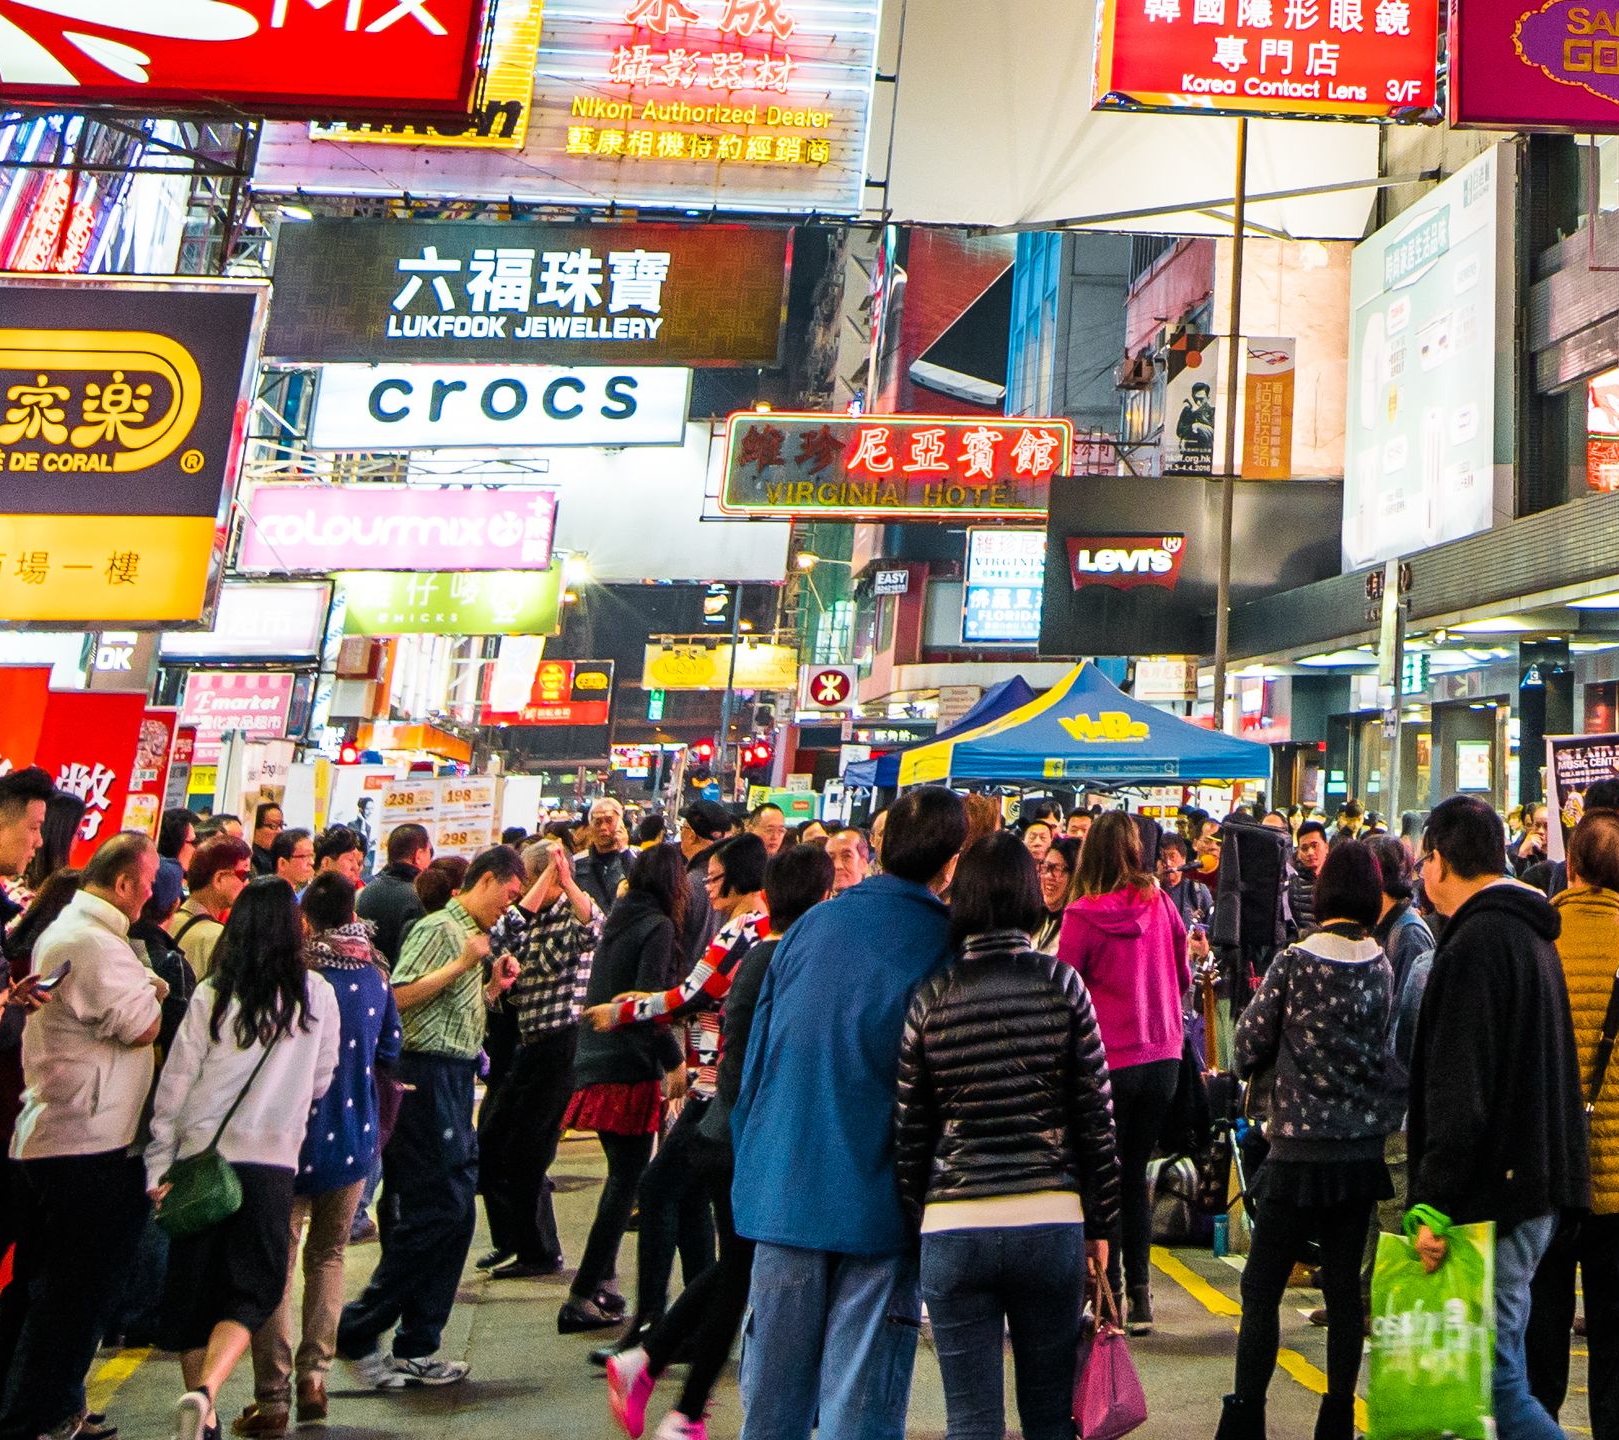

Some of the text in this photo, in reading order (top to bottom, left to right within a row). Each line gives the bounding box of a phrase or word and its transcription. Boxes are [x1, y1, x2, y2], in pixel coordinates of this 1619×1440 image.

[1212, 37, 1340, 77] 專門店
[1182, 74, 1421, 102] Korea Contact Lens 3/F
[641, 98, 834, 129] Authorized Dealer
[392, 247, 672, 315] 六福珠寶
[387, 316, 664, 341] LUKFOOK JEWELLERY
[367, 370, 640, 426] crocs
[10, 453, 113, 474] DE CORAL
[766, 481, 904, 510] VIRGINIA
